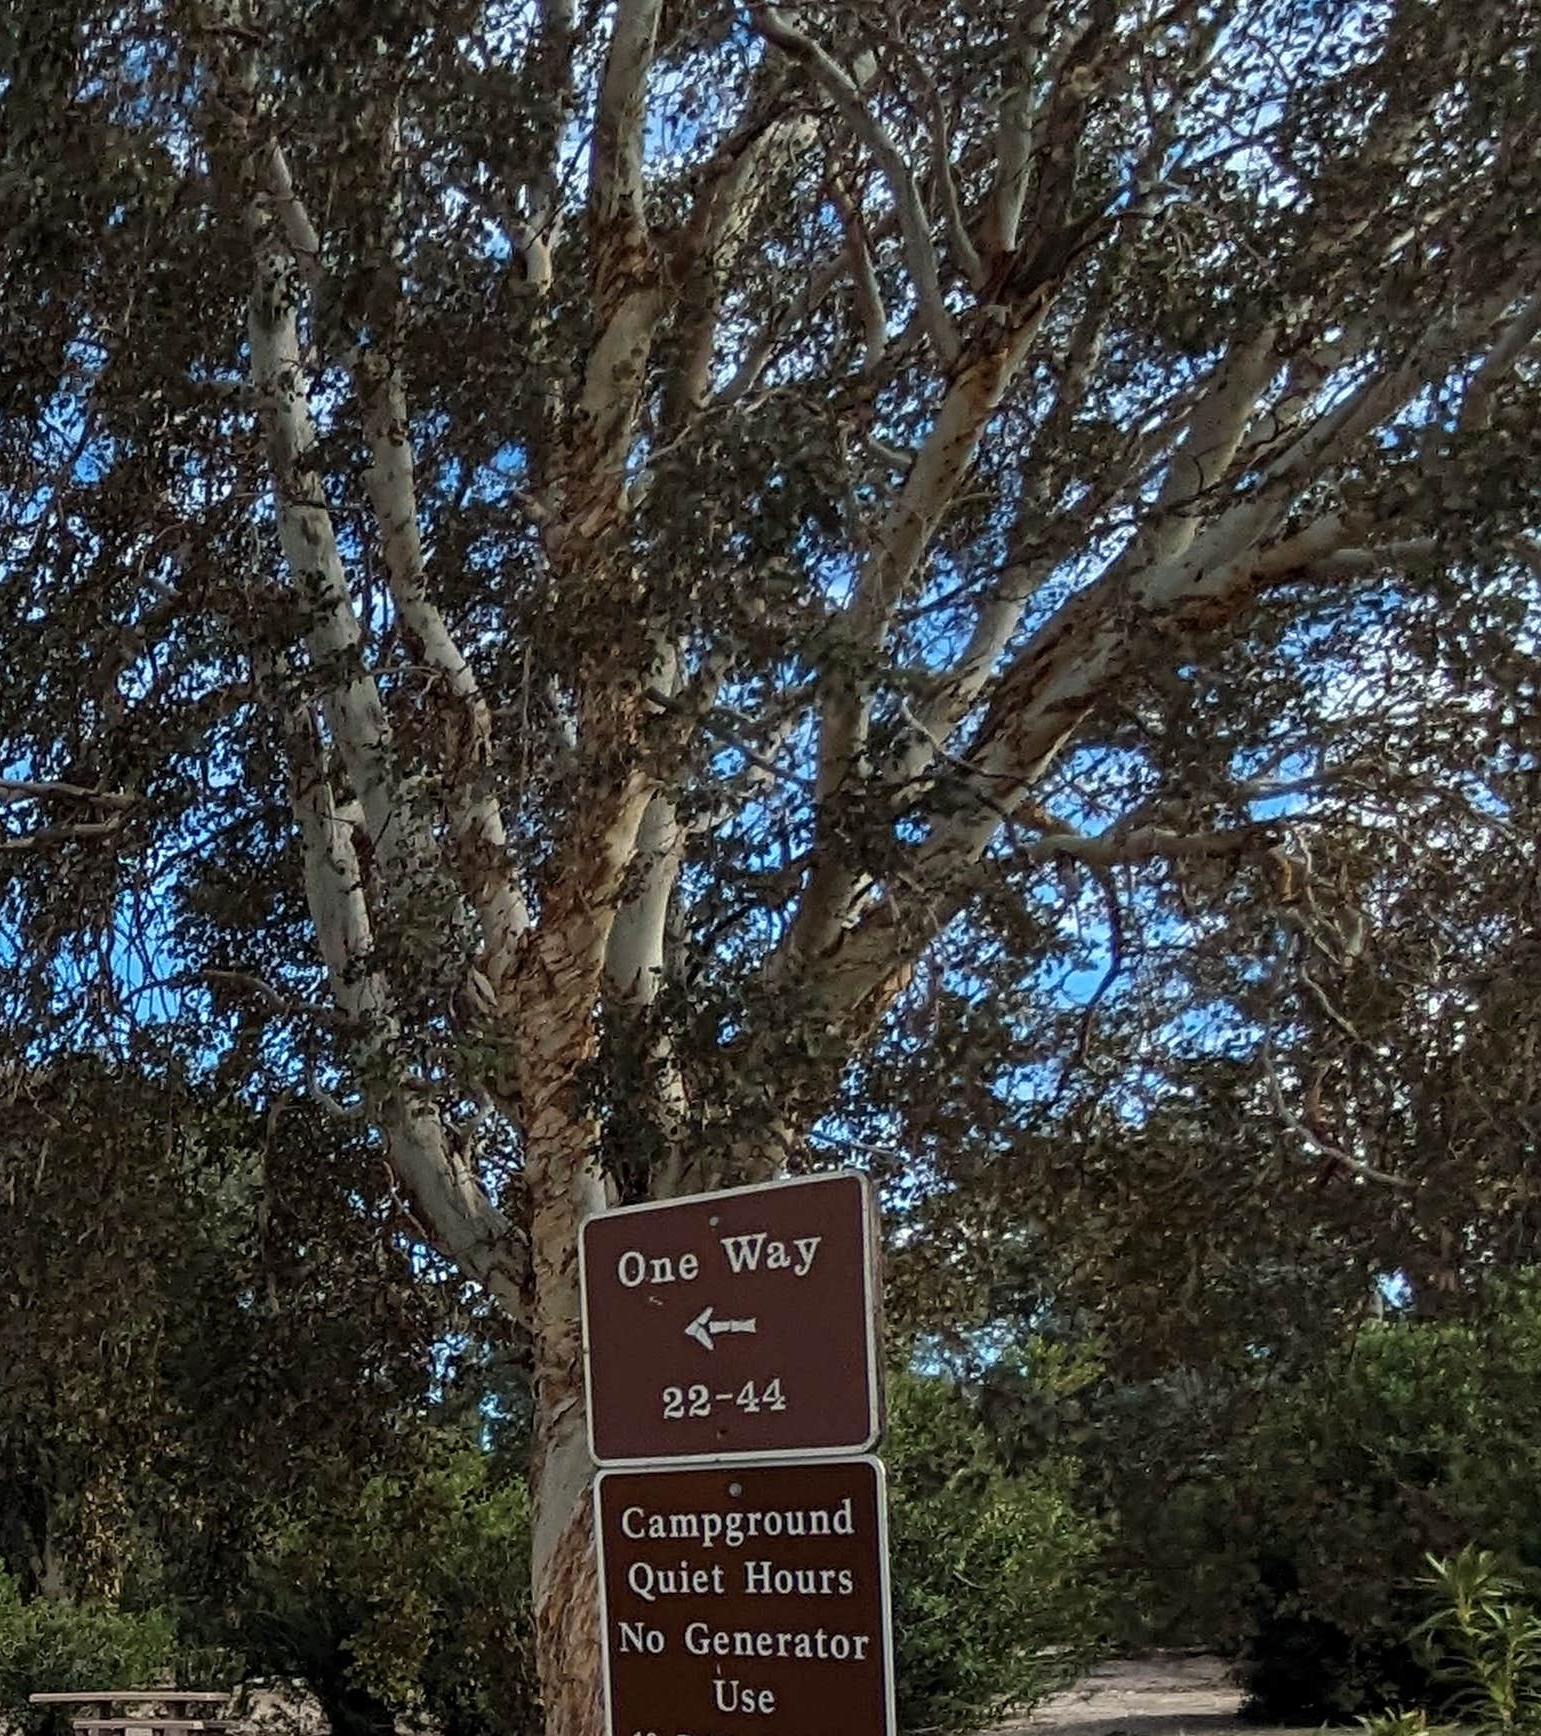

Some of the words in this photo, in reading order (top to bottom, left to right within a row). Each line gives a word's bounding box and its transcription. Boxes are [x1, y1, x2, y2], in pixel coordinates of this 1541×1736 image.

[618, 1251, 700, 1287] One
[721, 1232, 821, 1276] Way
[663, 1378, 786, 1419] 22-44
[621, 1498, 855, 1547] Campground
[628, 1560, 725, 1601] Quiet
[744, 1561, 853, 1594] Hours
[618, 1622, 665, 1653] No
[685, 1622, 870, 1660] Generator
[713, 1680, 776, 1714] Use
